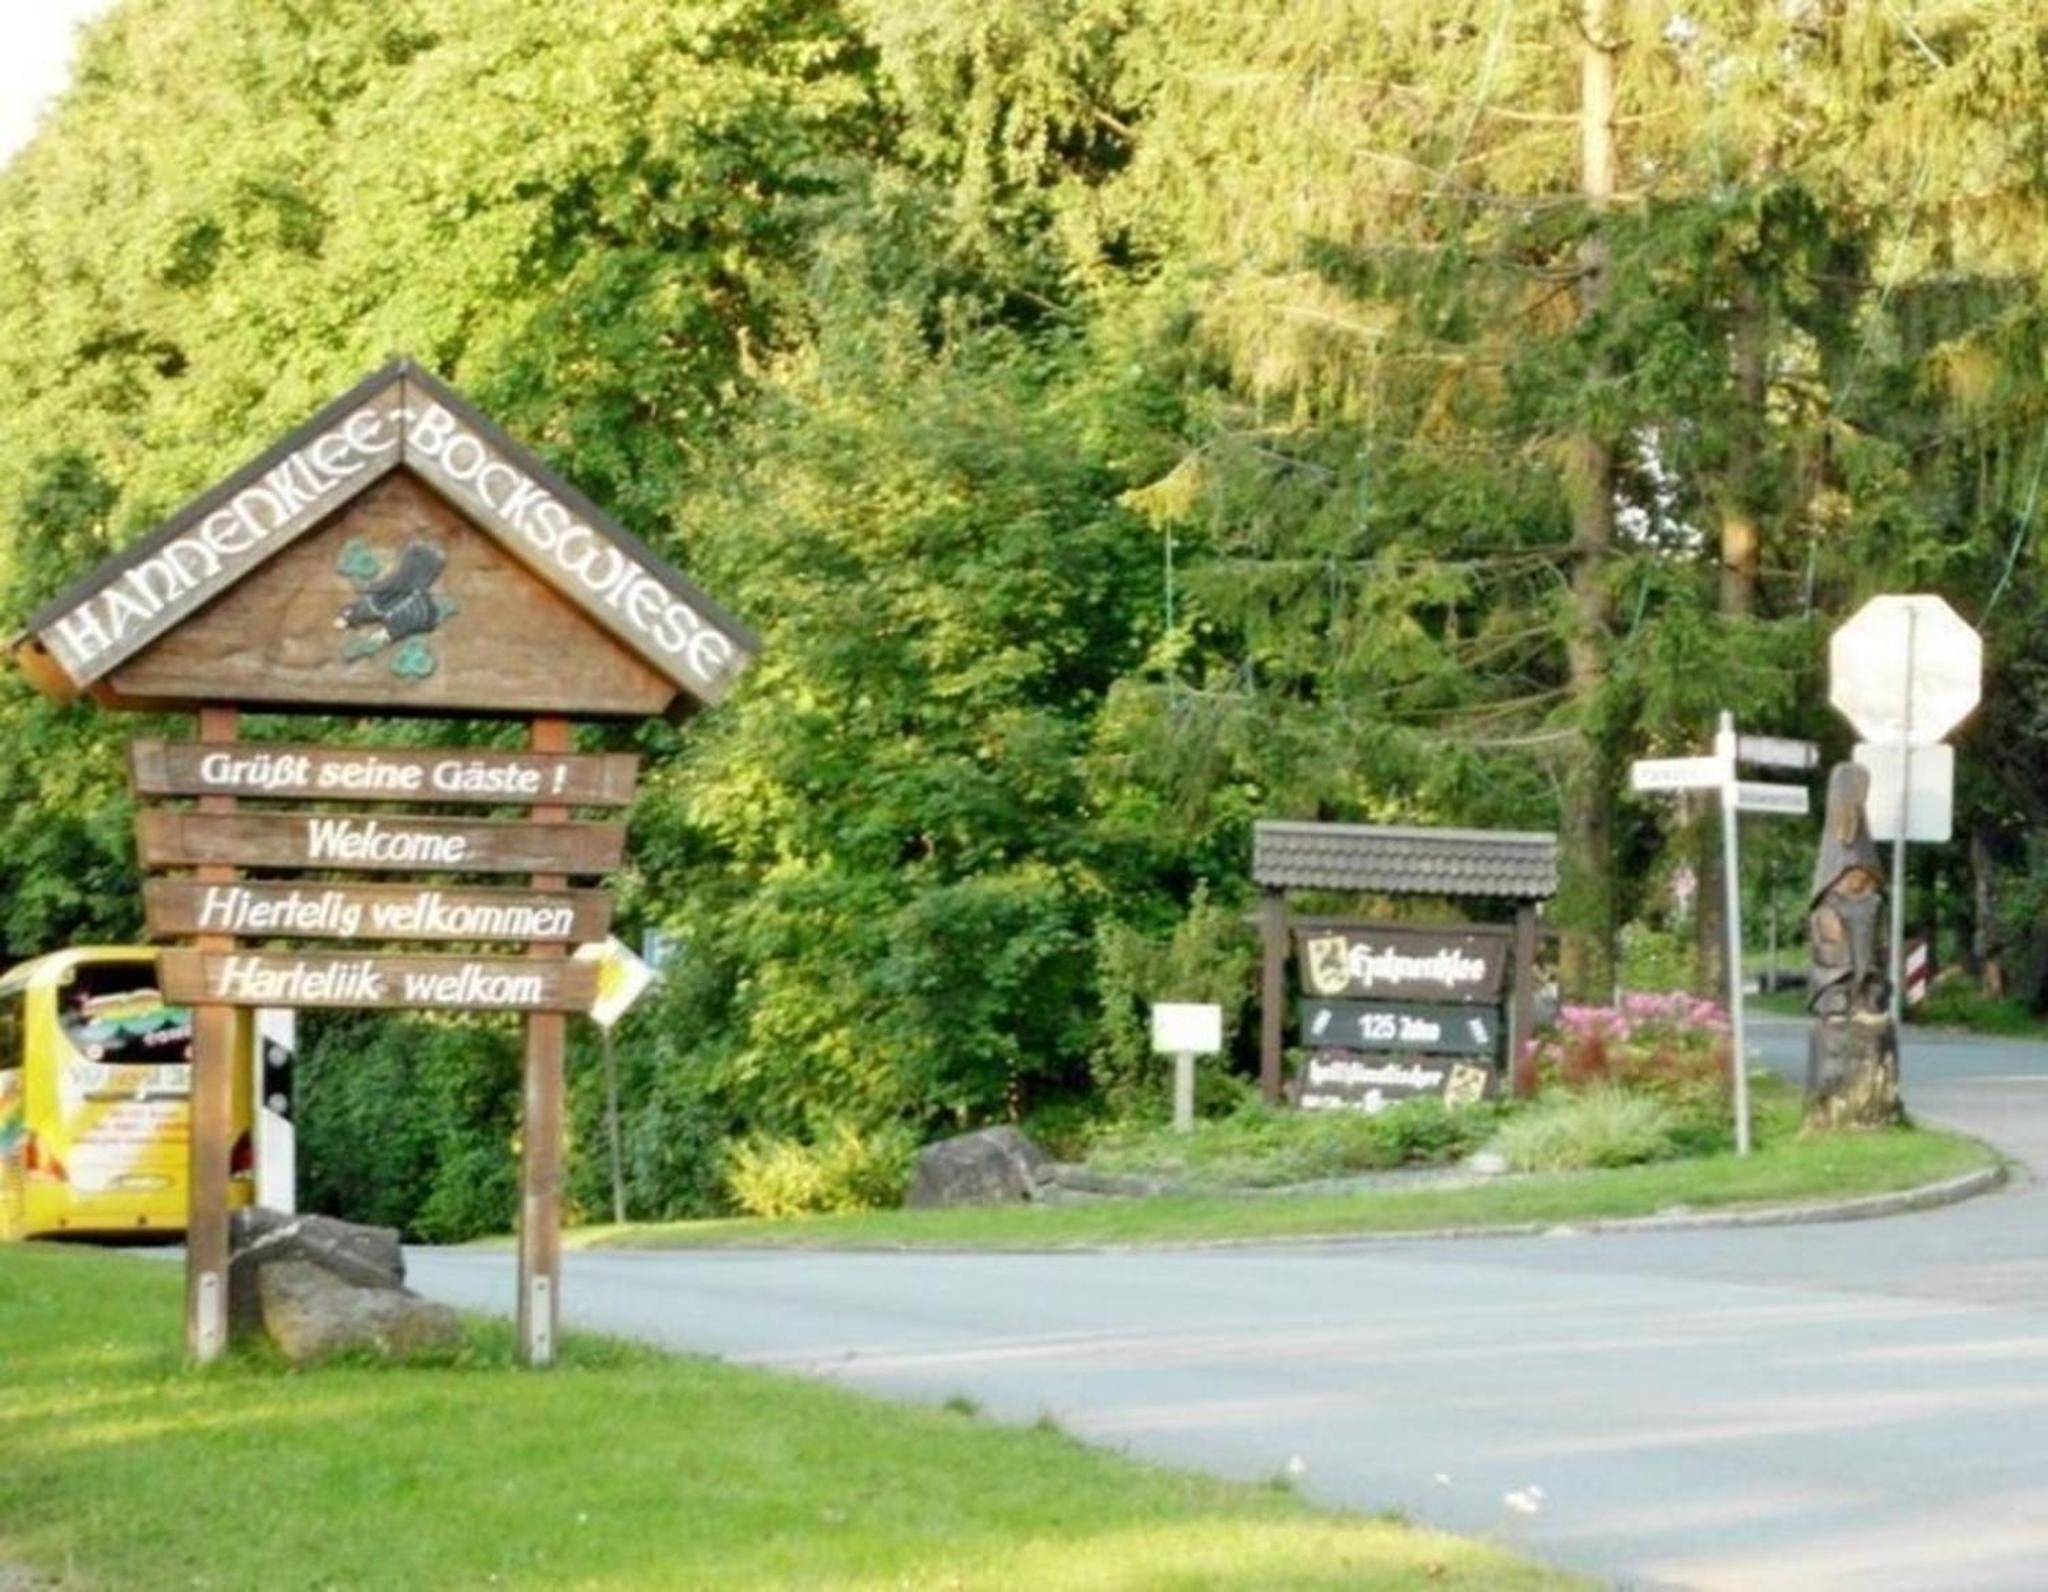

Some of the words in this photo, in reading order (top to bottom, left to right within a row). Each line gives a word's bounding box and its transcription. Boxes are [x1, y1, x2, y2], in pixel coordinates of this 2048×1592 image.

[407, 403, 731, 681] BOCKSWIESE
[201, 753, 309, 790] Grüßt
[318, 757, 423, 790] seine
[432, 760, 541, 794] Gäste
[307, 819, 466, 862] Welcome
[199, 886, 363, 935] Hjertelig
[371, 892, 574, 936] velkommen
[404, 963, 543, 1004] welkom
[1357, 1013, 1396, 1040] 125
